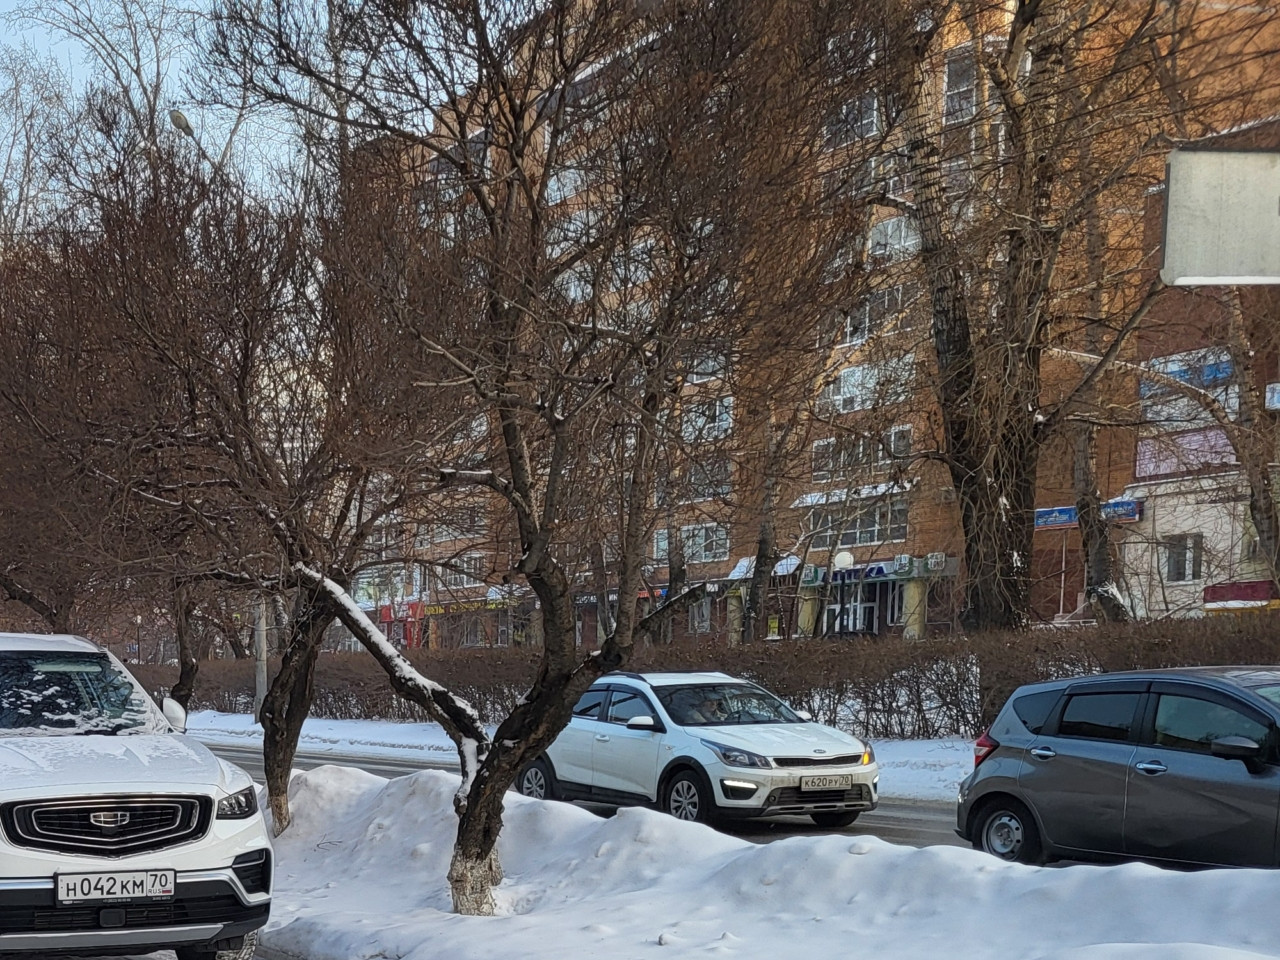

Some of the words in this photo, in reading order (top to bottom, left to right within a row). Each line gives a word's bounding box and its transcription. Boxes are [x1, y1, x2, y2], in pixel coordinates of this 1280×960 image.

[840, 776, 850, 784] 70
[66, 876, 144, 897] Н042КМ
[149, 873, 169, 888] 70
